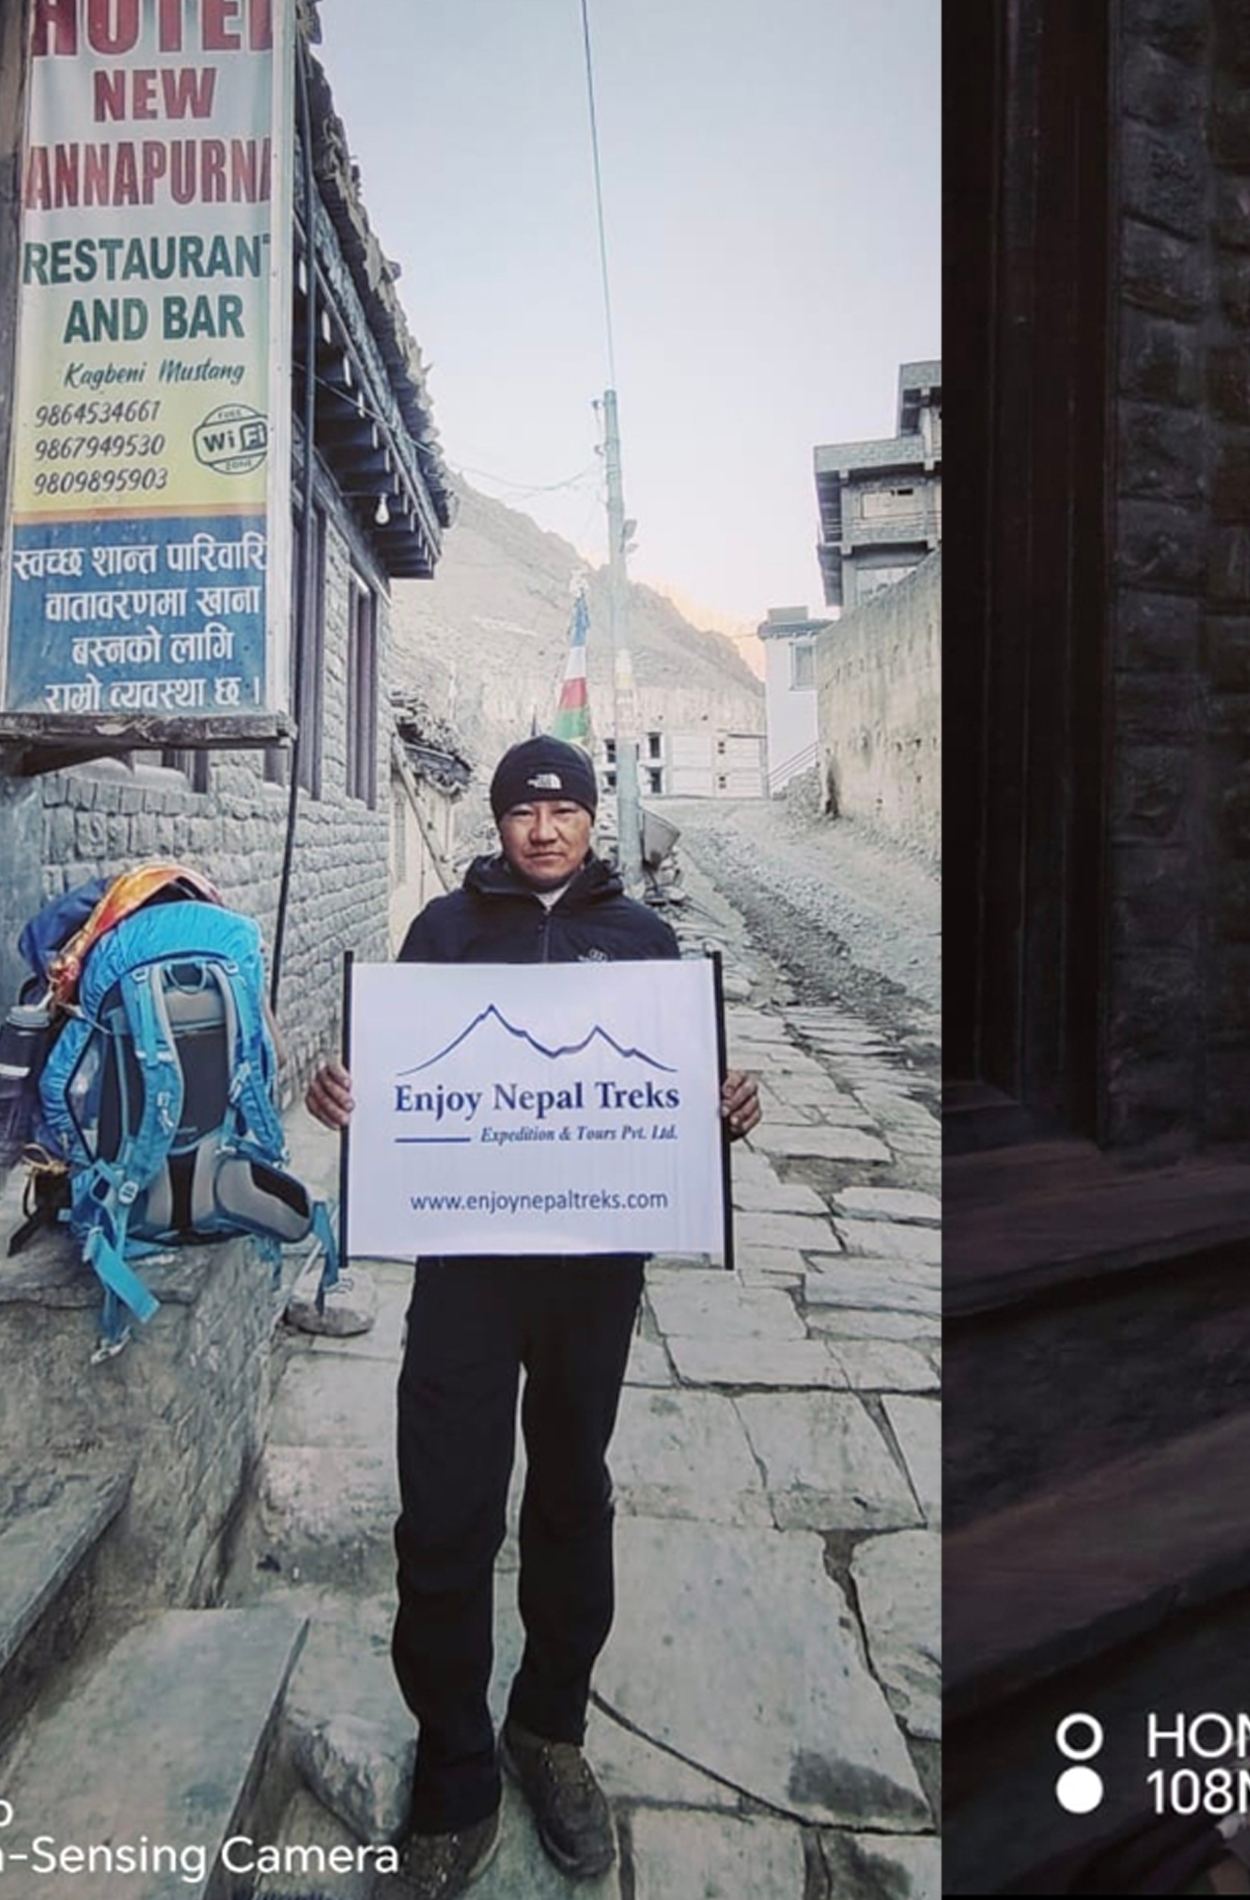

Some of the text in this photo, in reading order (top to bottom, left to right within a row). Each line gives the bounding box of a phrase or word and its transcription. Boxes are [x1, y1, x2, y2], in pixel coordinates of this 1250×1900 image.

[94, 67, 216, 122] NEW
[23, 234, 270, 285] RESTAURAN
[63, 295, 245, 344] AND BAR
[64, 357, 246, 390] Kagbeni Mustang
[34, 400, 162, 428] 9864534661
[34, 434, 165, 461] 9867949530
[33, 467, 168, 495] 9809895903
[14, 547, 85, 580] स्वच्छ
[91, 544, 158, 577] शान्त
[45, 585, 262, 622] वातावरणमा खाना
[71, 622, 235, 667] बस्नको लागि
[110, 678, 207, 710] व्यवस्था
[394, 1080, 681, 1121] Enjoy Nepal Treks
[480, 1124, 679, 1146] Expedition & Tours Pvt. Ltd.
[410, 1189, 669, 1215] www.enjoynepaltreks.com
